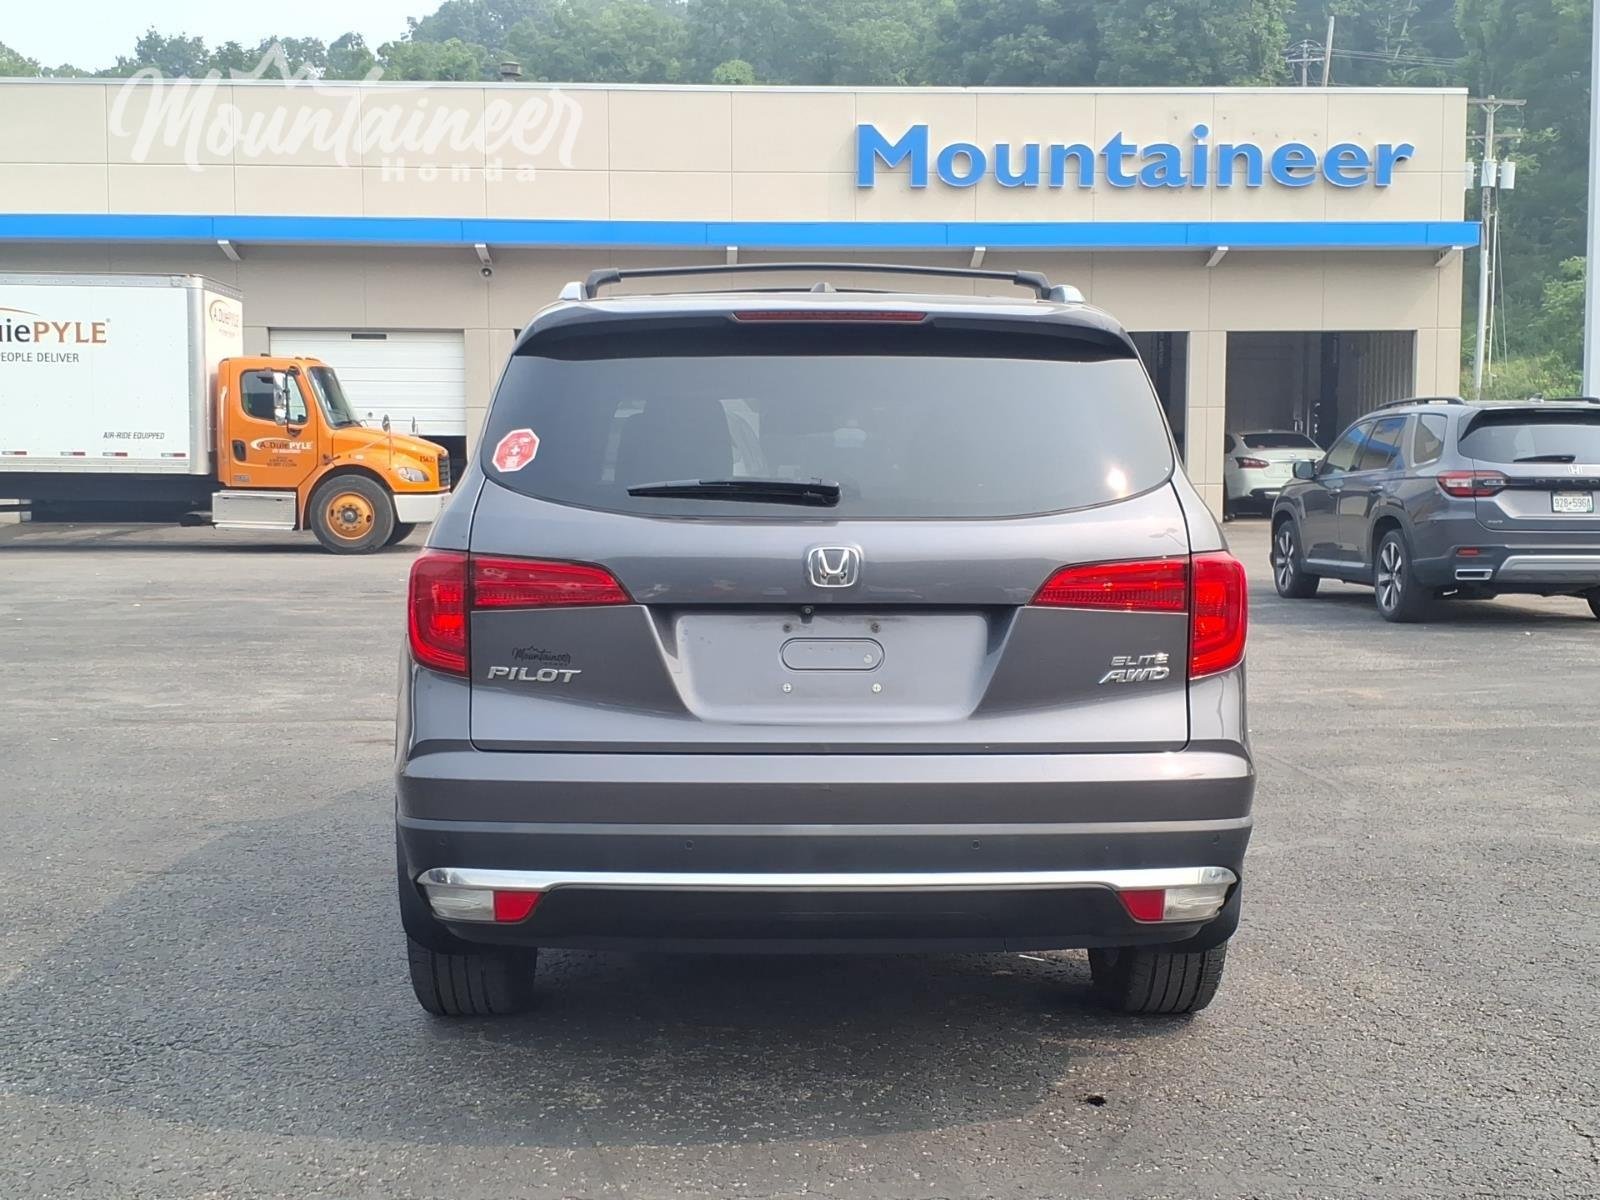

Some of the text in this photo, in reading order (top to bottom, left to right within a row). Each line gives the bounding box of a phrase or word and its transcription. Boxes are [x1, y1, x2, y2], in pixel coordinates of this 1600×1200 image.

[855, 122, 1415, 189] Mountaineer
[0, 318, 107, 343] iePYLE
[37, 352, 79, 363] DELIVER
[1110, 652, 1169, 666] ELITE
[487, 666, 582, 683] PILOT
[1098, 666, 1170, 684] AWD
